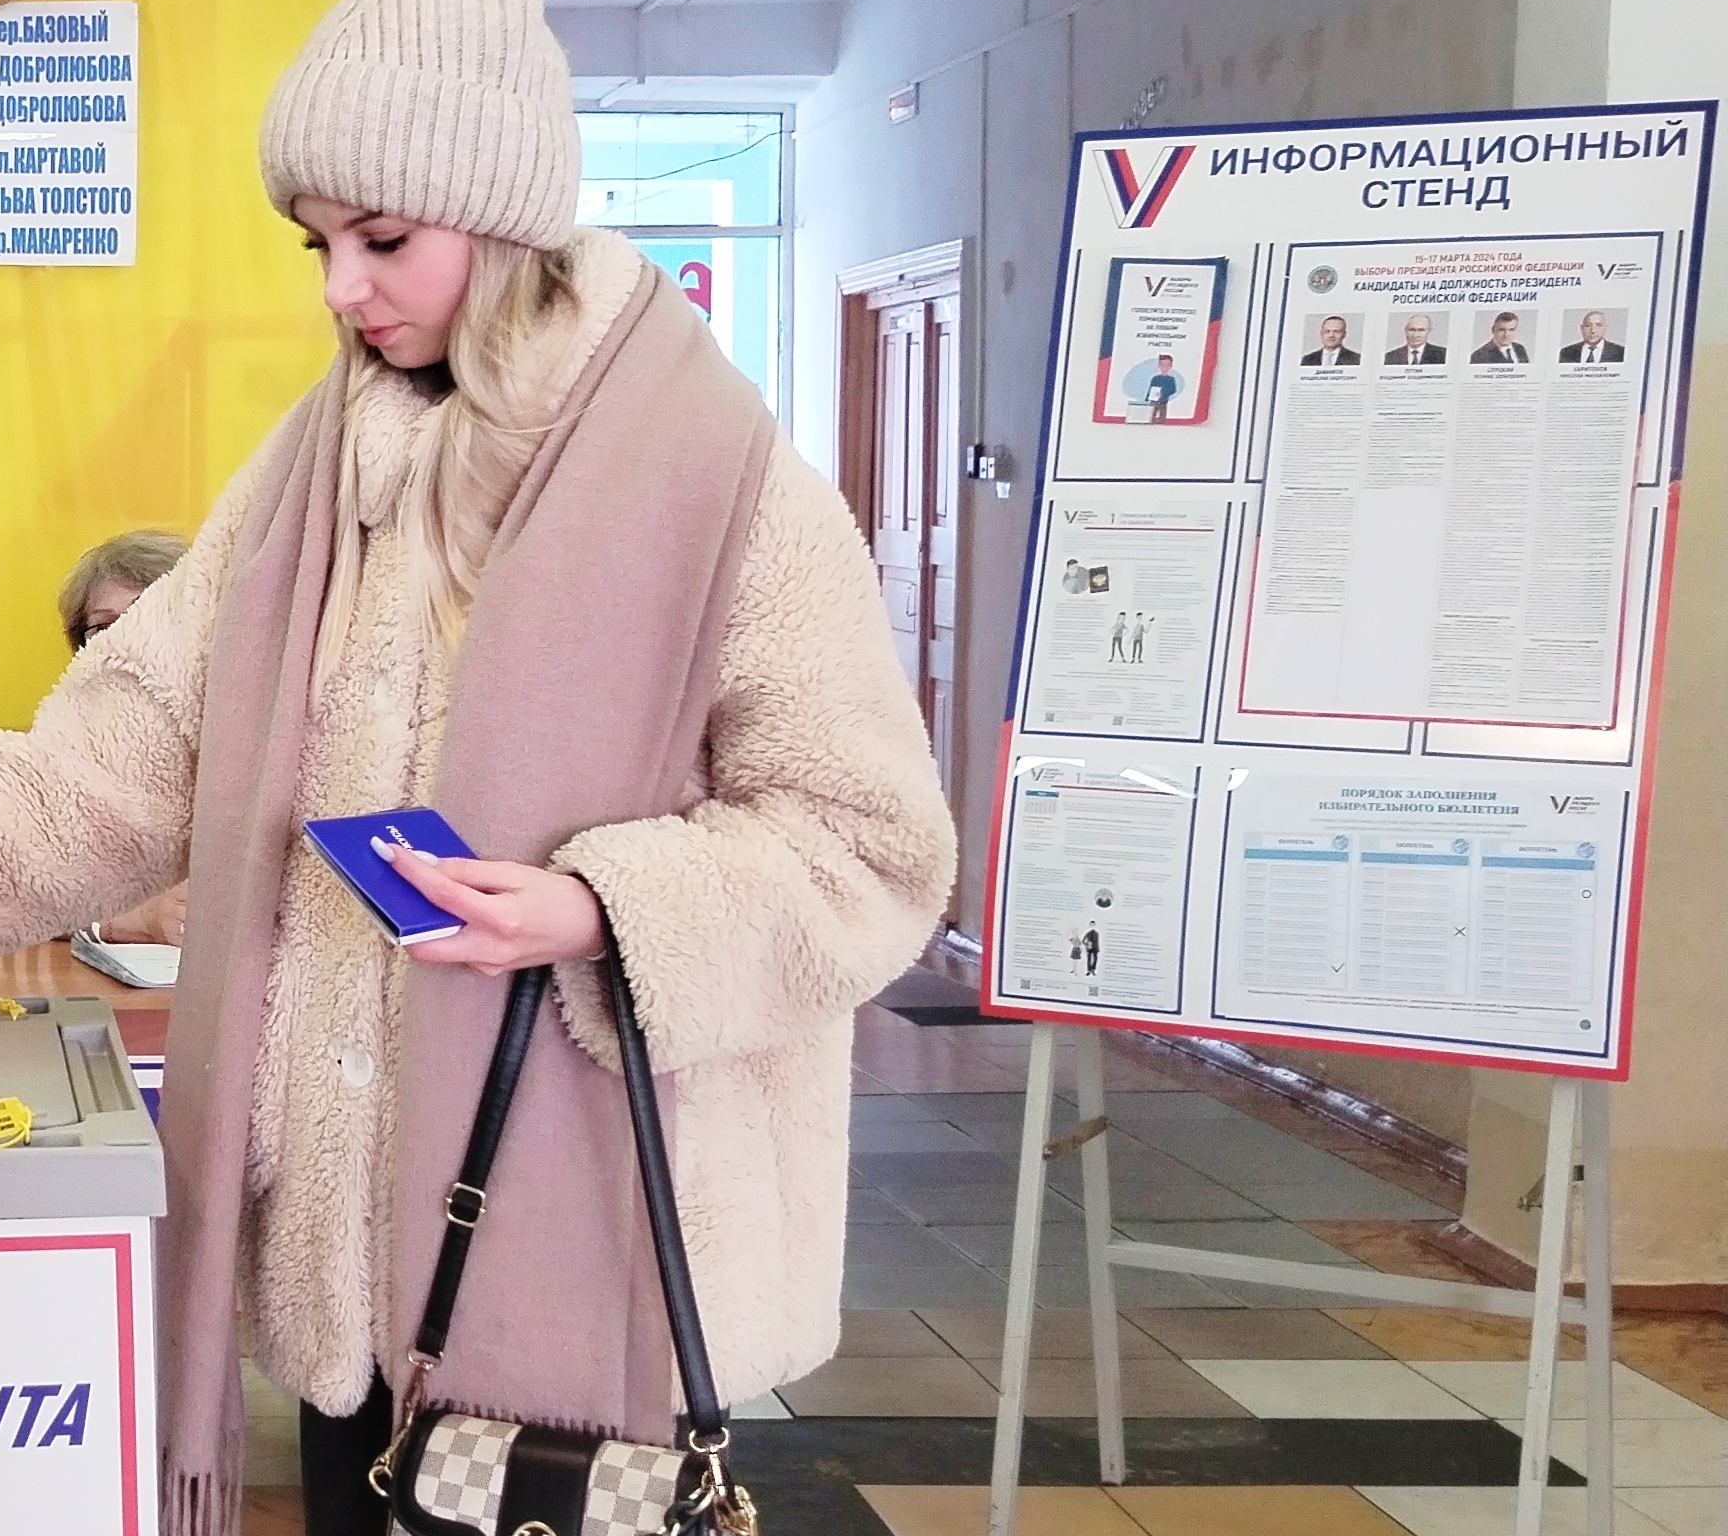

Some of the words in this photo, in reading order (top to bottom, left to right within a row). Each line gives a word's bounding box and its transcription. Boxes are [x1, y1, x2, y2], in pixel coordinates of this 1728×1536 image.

[1209, 119, 1690, 178] ИНФОРМАЦИОННЫЙ
[39, 186, 132, 215] ТОЛСТОГО
[1361, 175, 1511, 212] СТЕНД
[1439, 254, 1470, 263] МАРТА
[1472, 253, 1495, 262] 2024
[1498, 252, 1522, 262] ГОДА
[1354, 265, 1395, 276] ВЫБОРЫ
[1397, 264, 1456, 276] ПРЕЗИДЕНТА
[1458, 262, 1522, 274] РОССИЙСКОЙ
[1524, 261, 1585, 273] ФЕДЕРАЦИИ
[1353, 280, 1420, 292] КАНДИДАТЫ
[1422, 279, 1436, 290] НА
[1439, 278, 1508, 291] ДОЛЖНОСТЬ
[1510, 276, 1582, 289] ПРЕЗИДЕНТА
[1392, 290, 1465, 305] РОССИЙСКОЙ
[1468, 291, 1538, 304] ФЕДЕРАЦИИ
[1341, 787, 1403, 799] ПОРЯДОК
[1405, 789, 1498, 801] ЗАПОЛНЕНИЯ
